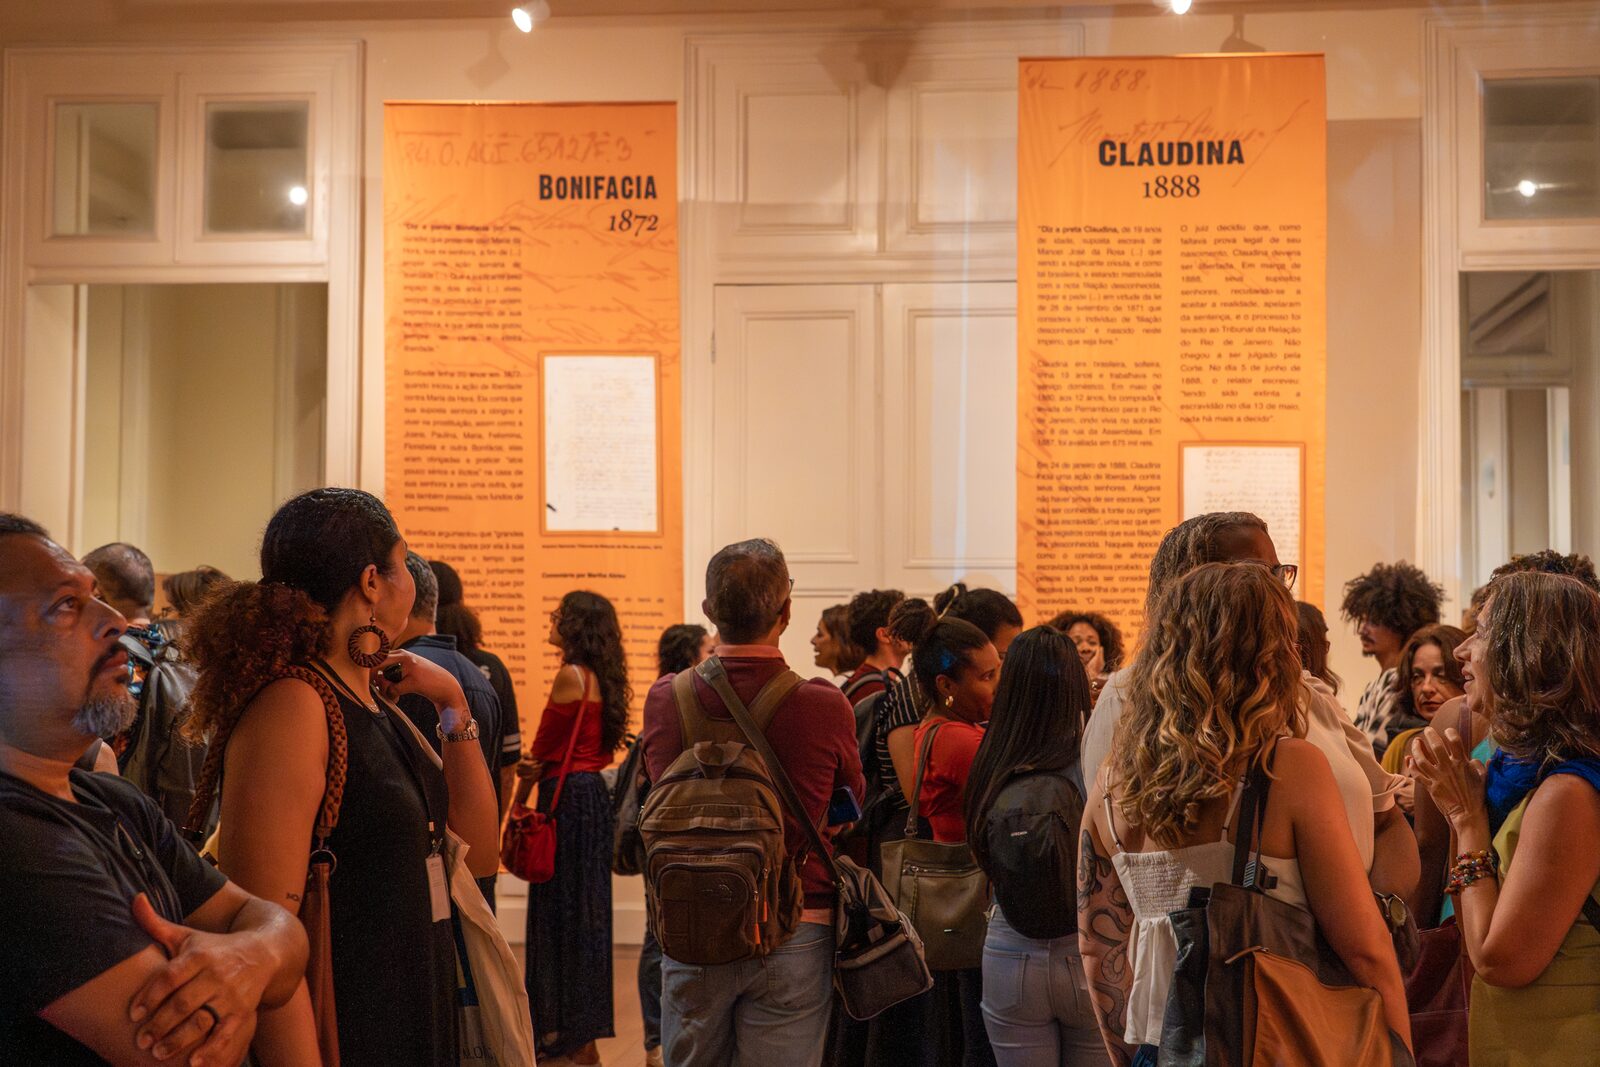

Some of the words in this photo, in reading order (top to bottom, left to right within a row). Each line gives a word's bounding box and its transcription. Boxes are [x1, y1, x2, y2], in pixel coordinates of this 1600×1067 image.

[1099, 140, 1245, 167] CLAUDINA
[539, 174, 658, 200] BONIFACIA
[1142, 175, 1201, 199] 1888
[609, 209, 658, 237] 1872
